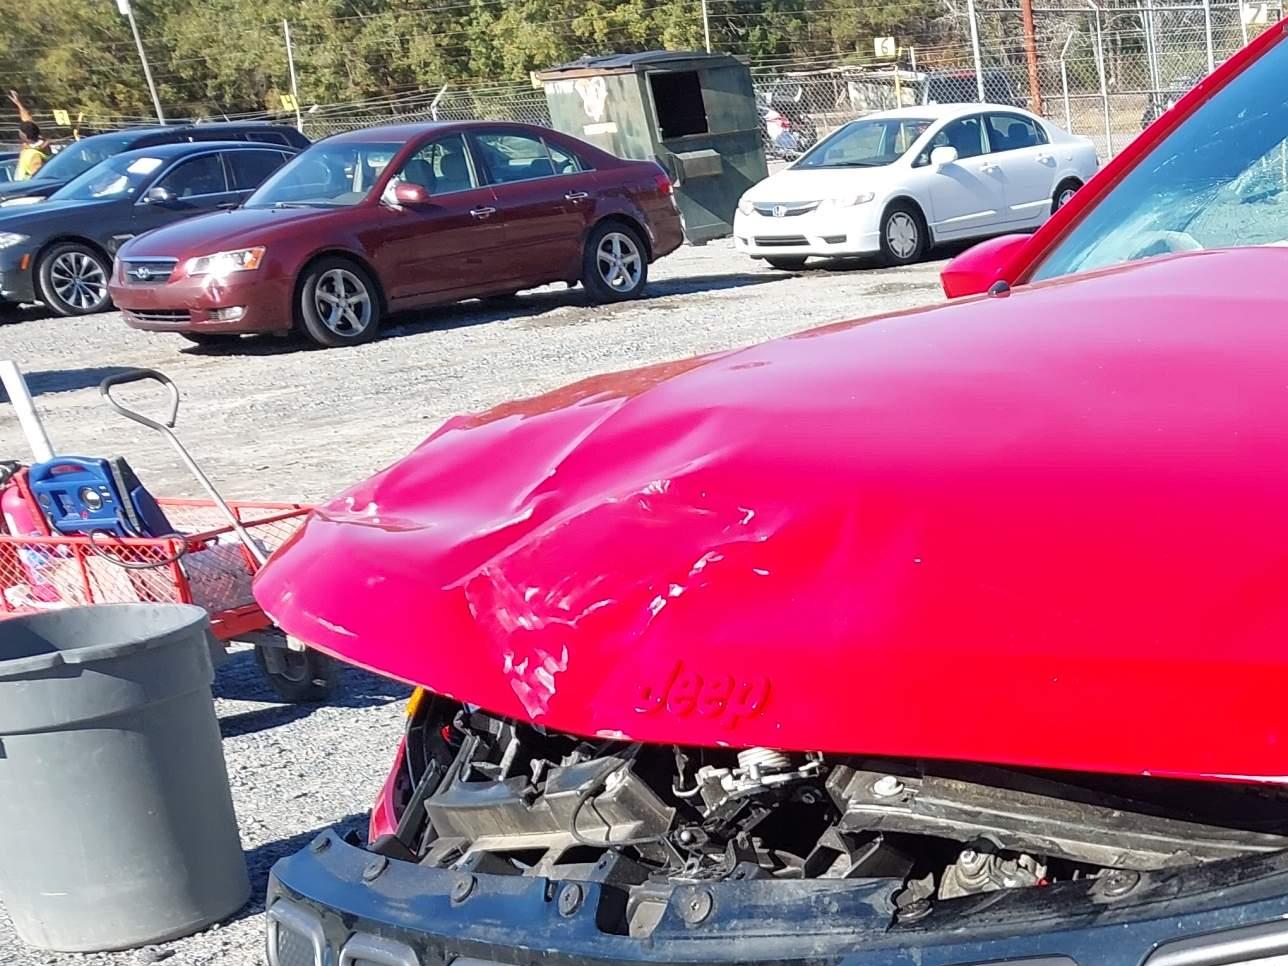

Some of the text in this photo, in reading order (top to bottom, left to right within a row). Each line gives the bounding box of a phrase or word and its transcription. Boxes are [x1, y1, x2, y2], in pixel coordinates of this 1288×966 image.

[1248, 2, 1261, 23] 7
[880, 38, 889, 55] 6
[638, 658, 774, 731] Jeep
